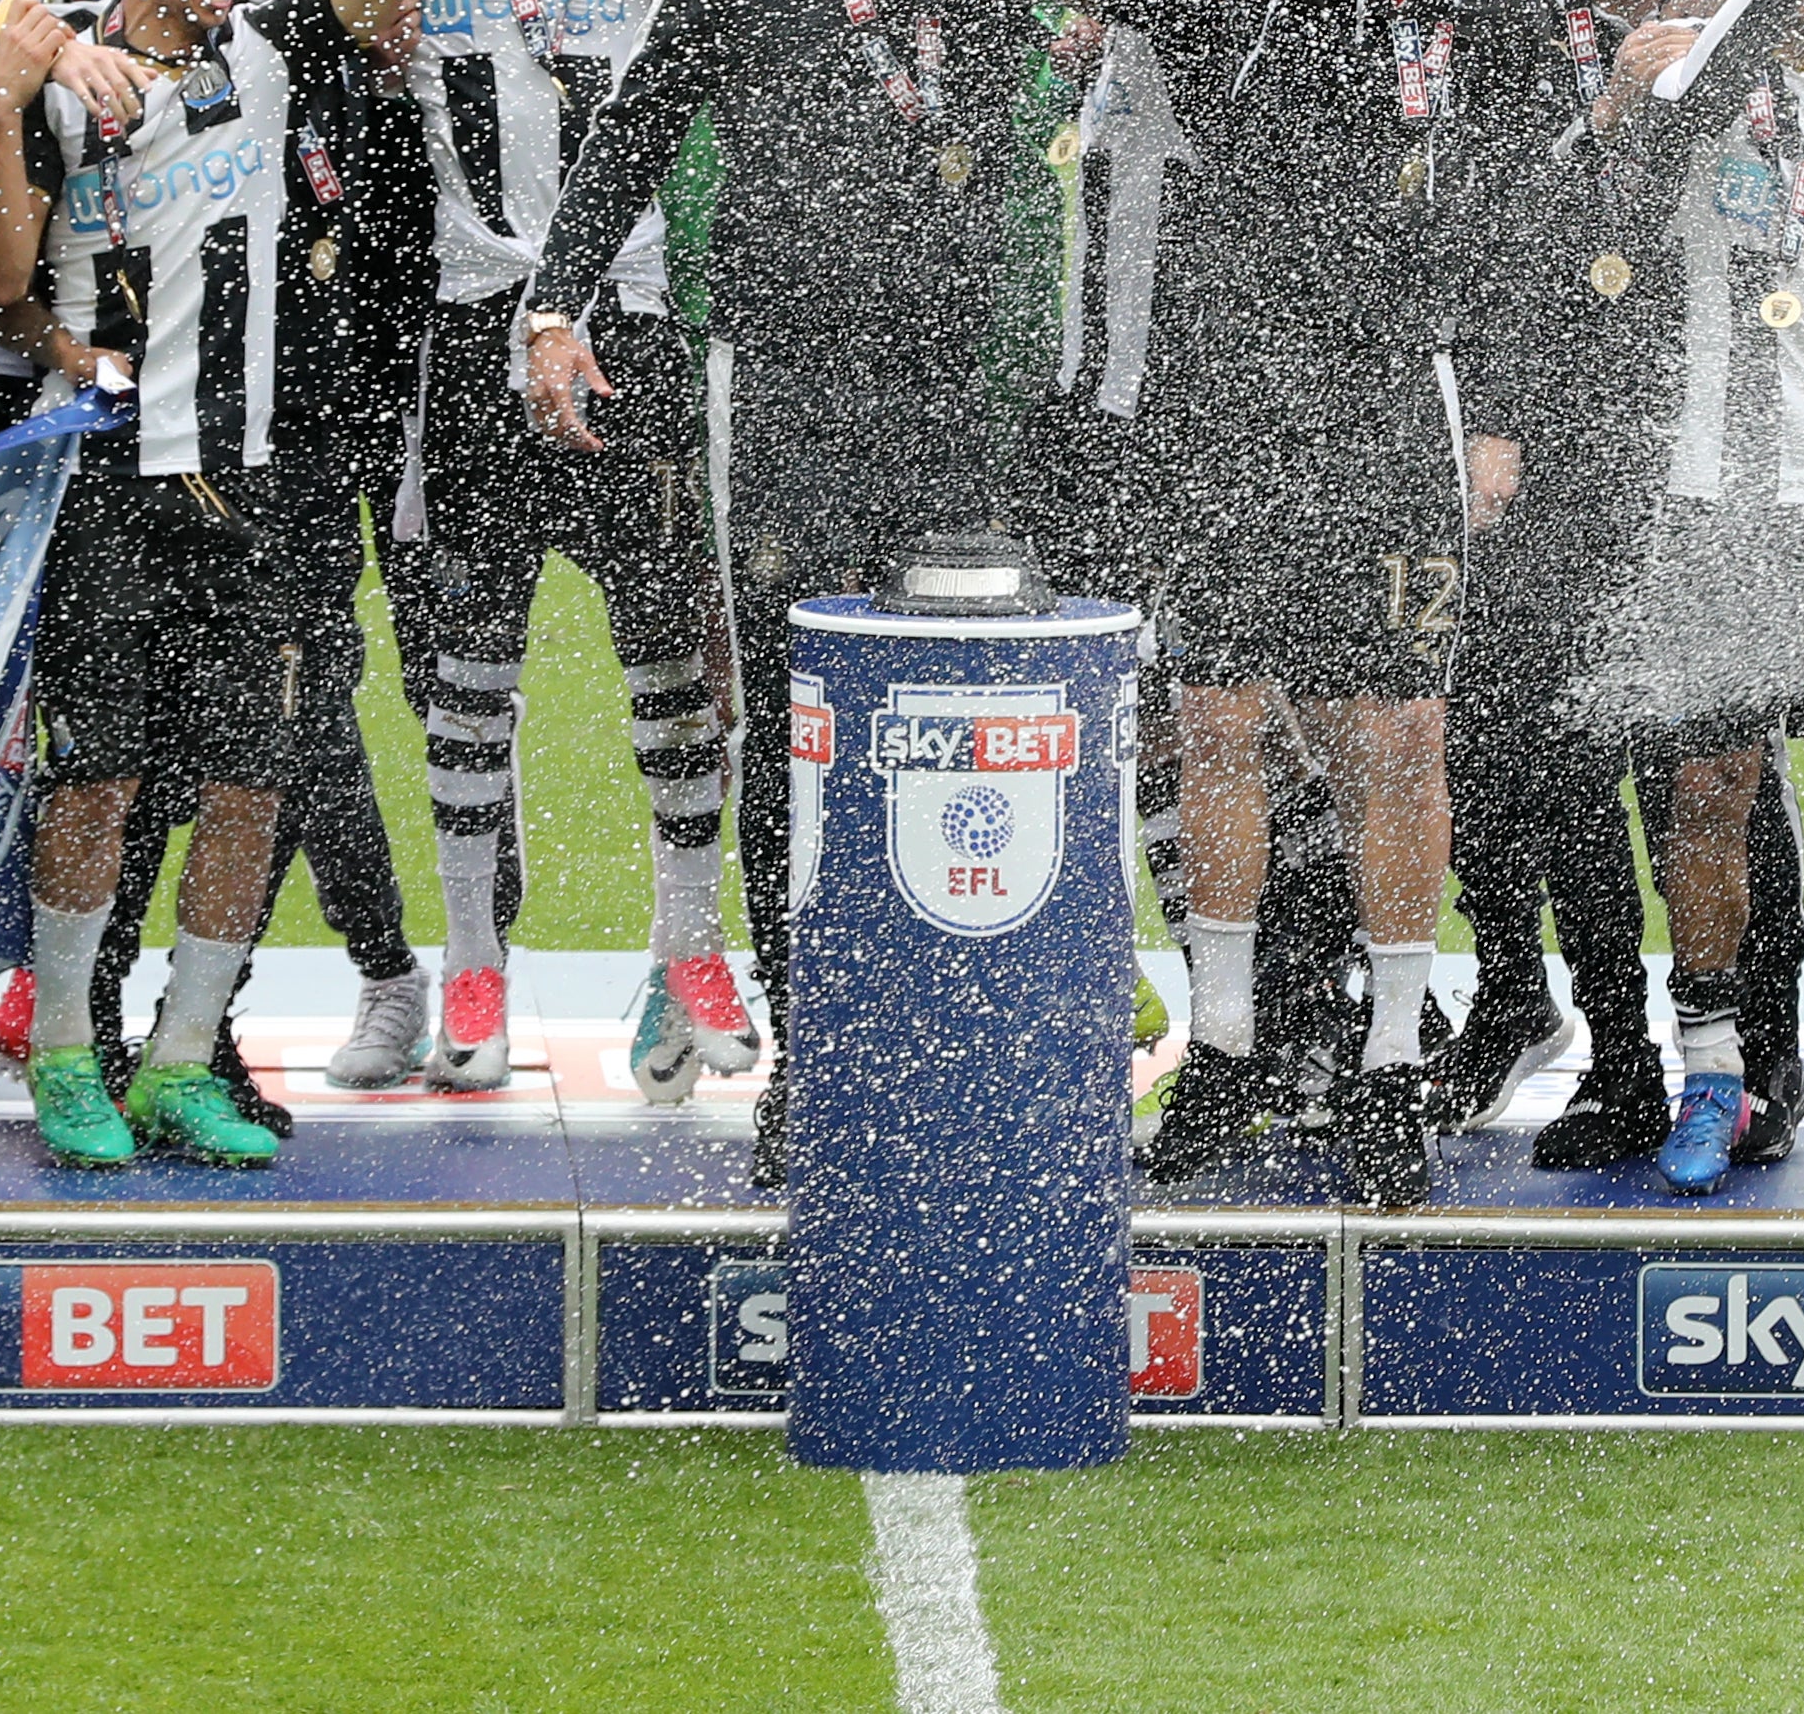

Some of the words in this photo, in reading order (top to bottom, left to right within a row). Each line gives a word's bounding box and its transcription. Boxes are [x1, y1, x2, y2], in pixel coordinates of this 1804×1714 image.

[1379, 553, 1458, 633] 12
[884, 719, 963, 771] sky
[984, 724, 1067, 763] BET
[947, 867, 1008, 897] EFL
[49, 1286, 248, 1367] BET
